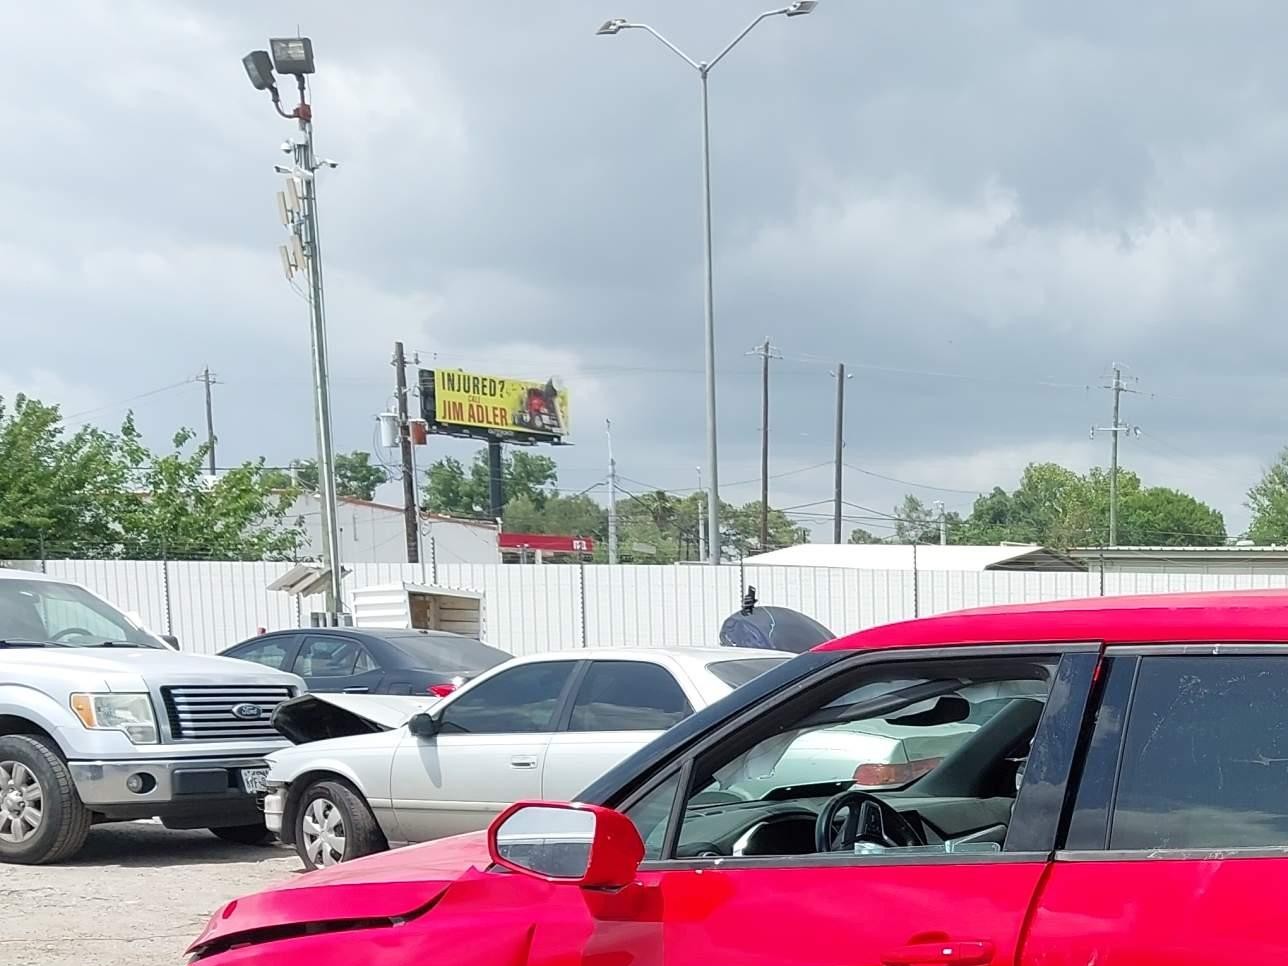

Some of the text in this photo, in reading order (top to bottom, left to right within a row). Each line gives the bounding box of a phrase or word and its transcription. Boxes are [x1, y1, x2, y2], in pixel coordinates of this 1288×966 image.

[441, 371, 505, 399] INJURED?
[442, 400, 508, 426] JIM ADLER
